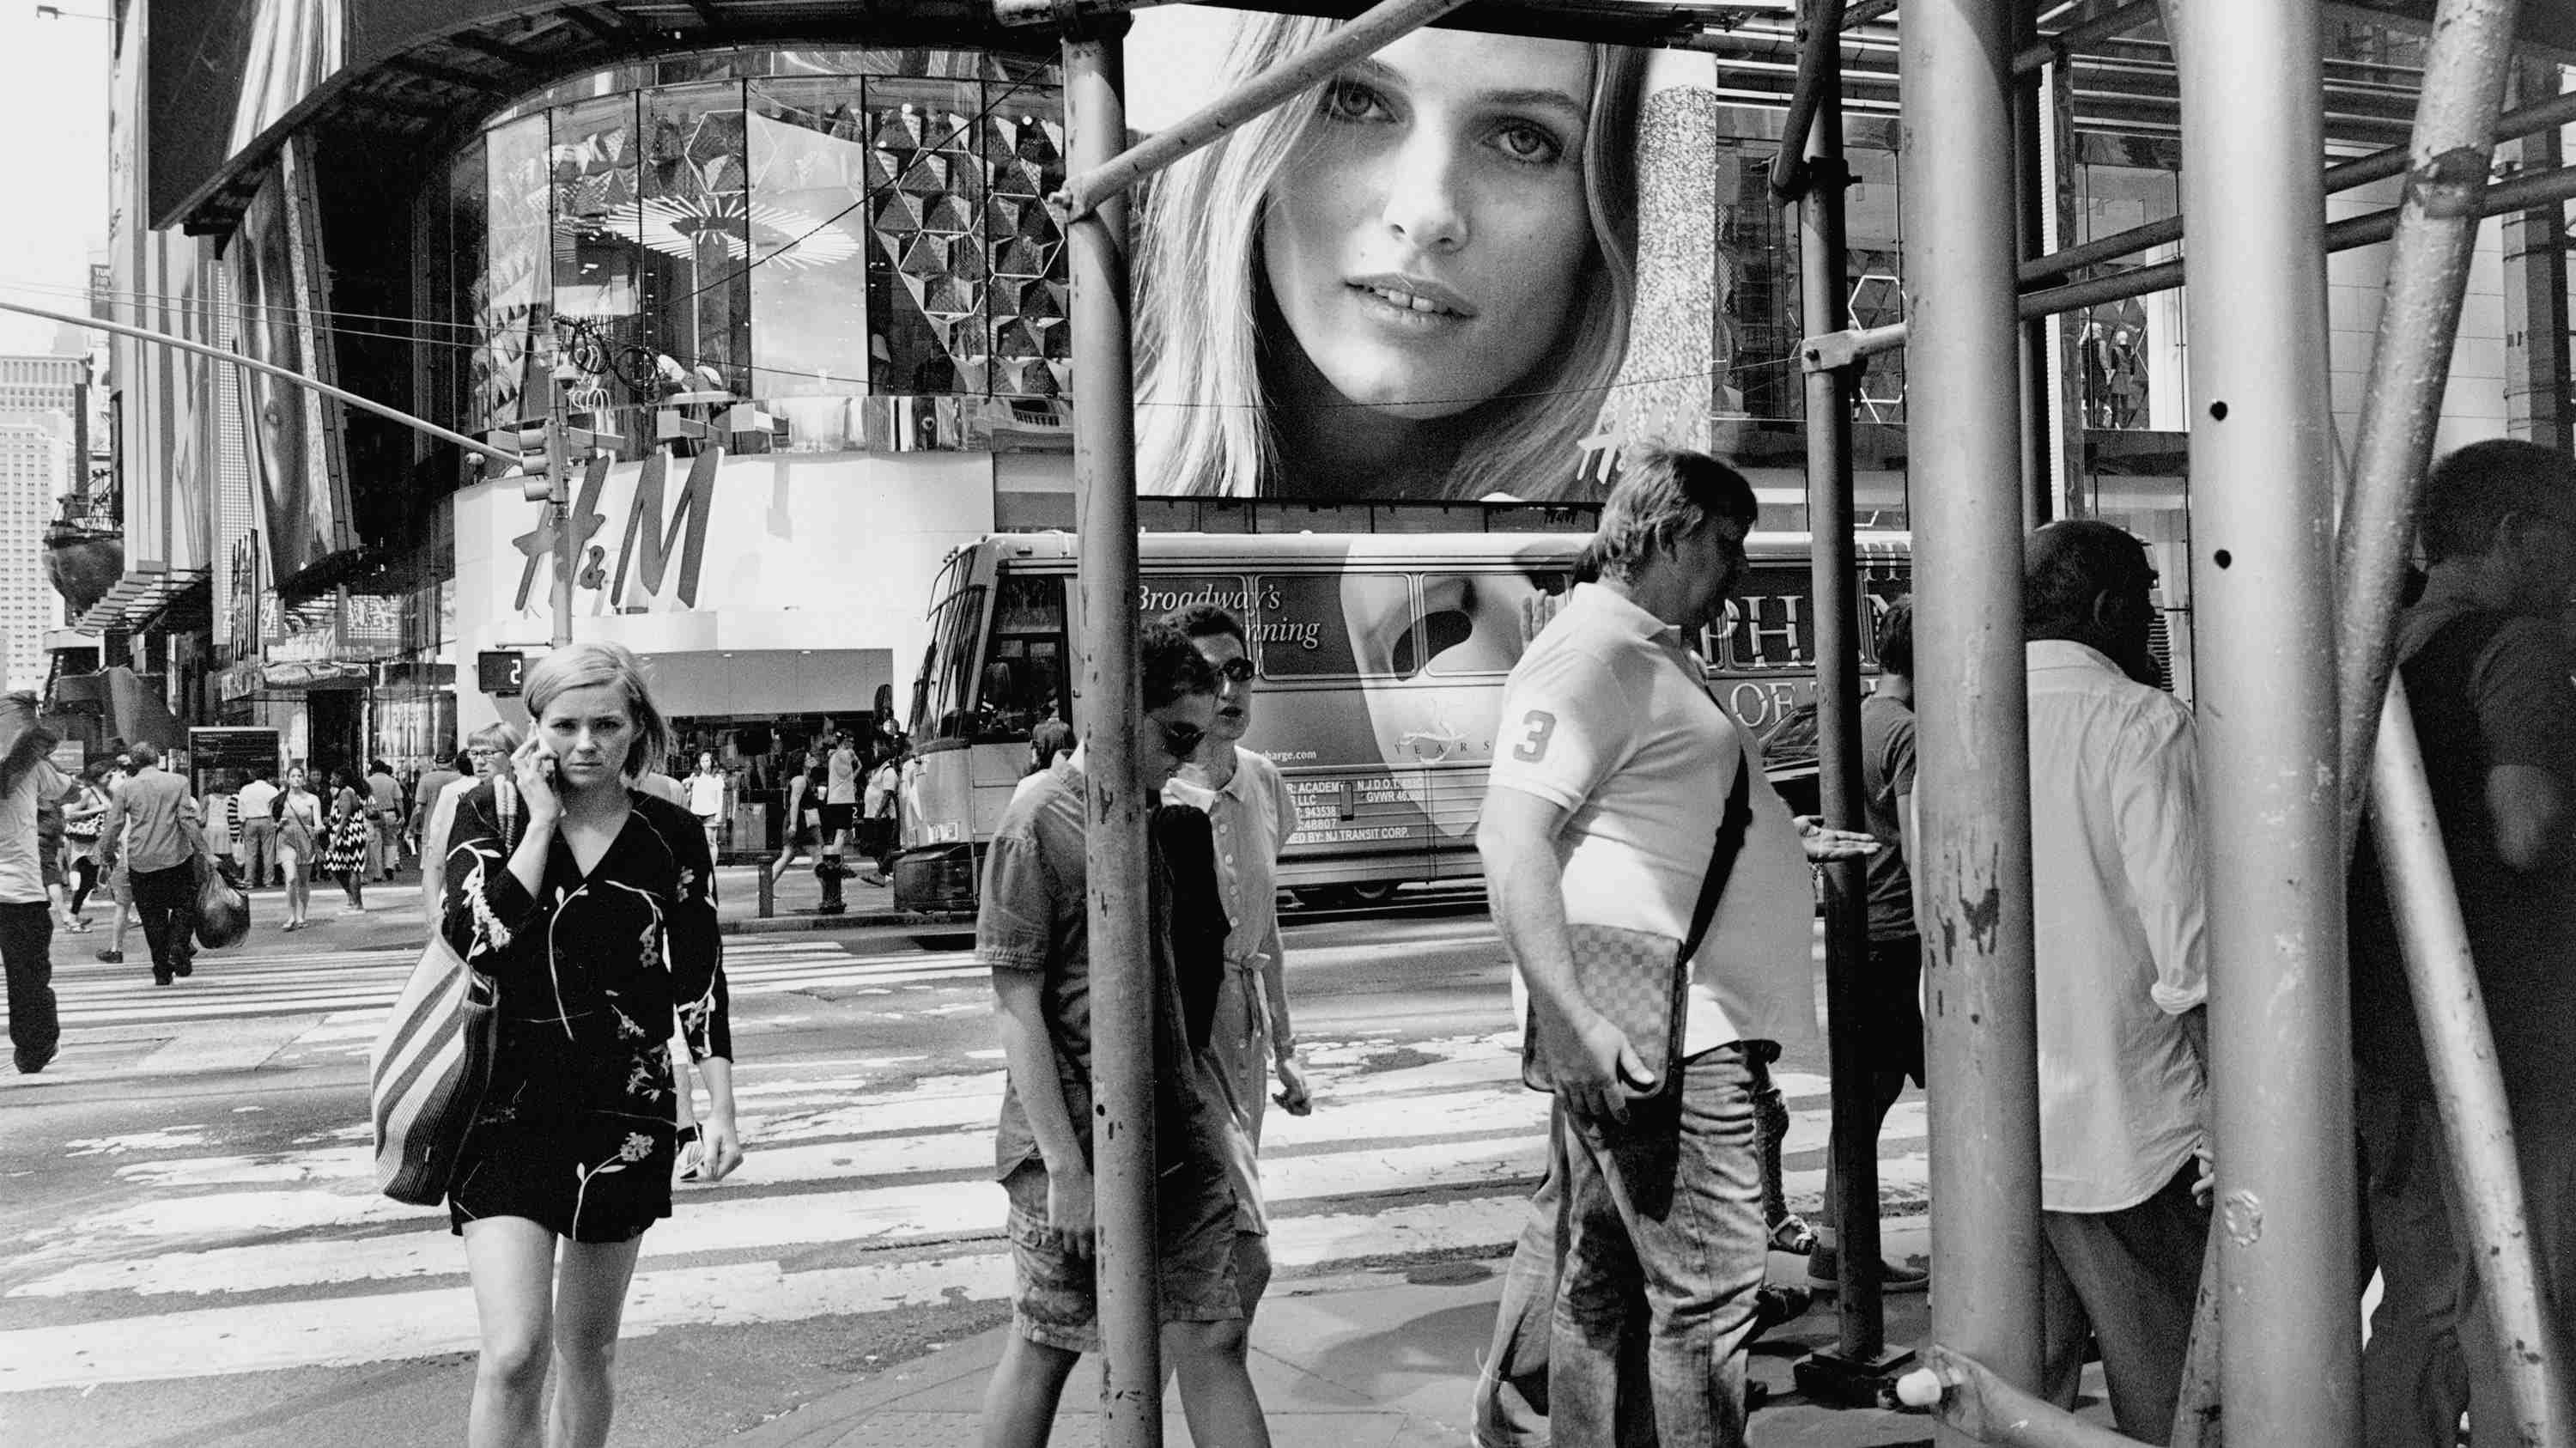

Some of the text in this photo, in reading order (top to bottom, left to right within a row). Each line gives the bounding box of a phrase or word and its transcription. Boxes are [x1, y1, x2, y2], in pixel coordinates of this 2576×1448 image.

[512, 446, 720, 611] H&M
[1139, 583, 1281, 616] Broadway's
[1244, 617, 1321, 649] nning
[510, 659, 521, 684] 2
[1513, 709, 1557, 763] 3
[1298, 794, 1316, 806] LLC
[1367, 791, 1394, 802] GVWR
[1325, 830, 1338, 842] NJ
[1339, 829, 1379, 841] TRANSIT
